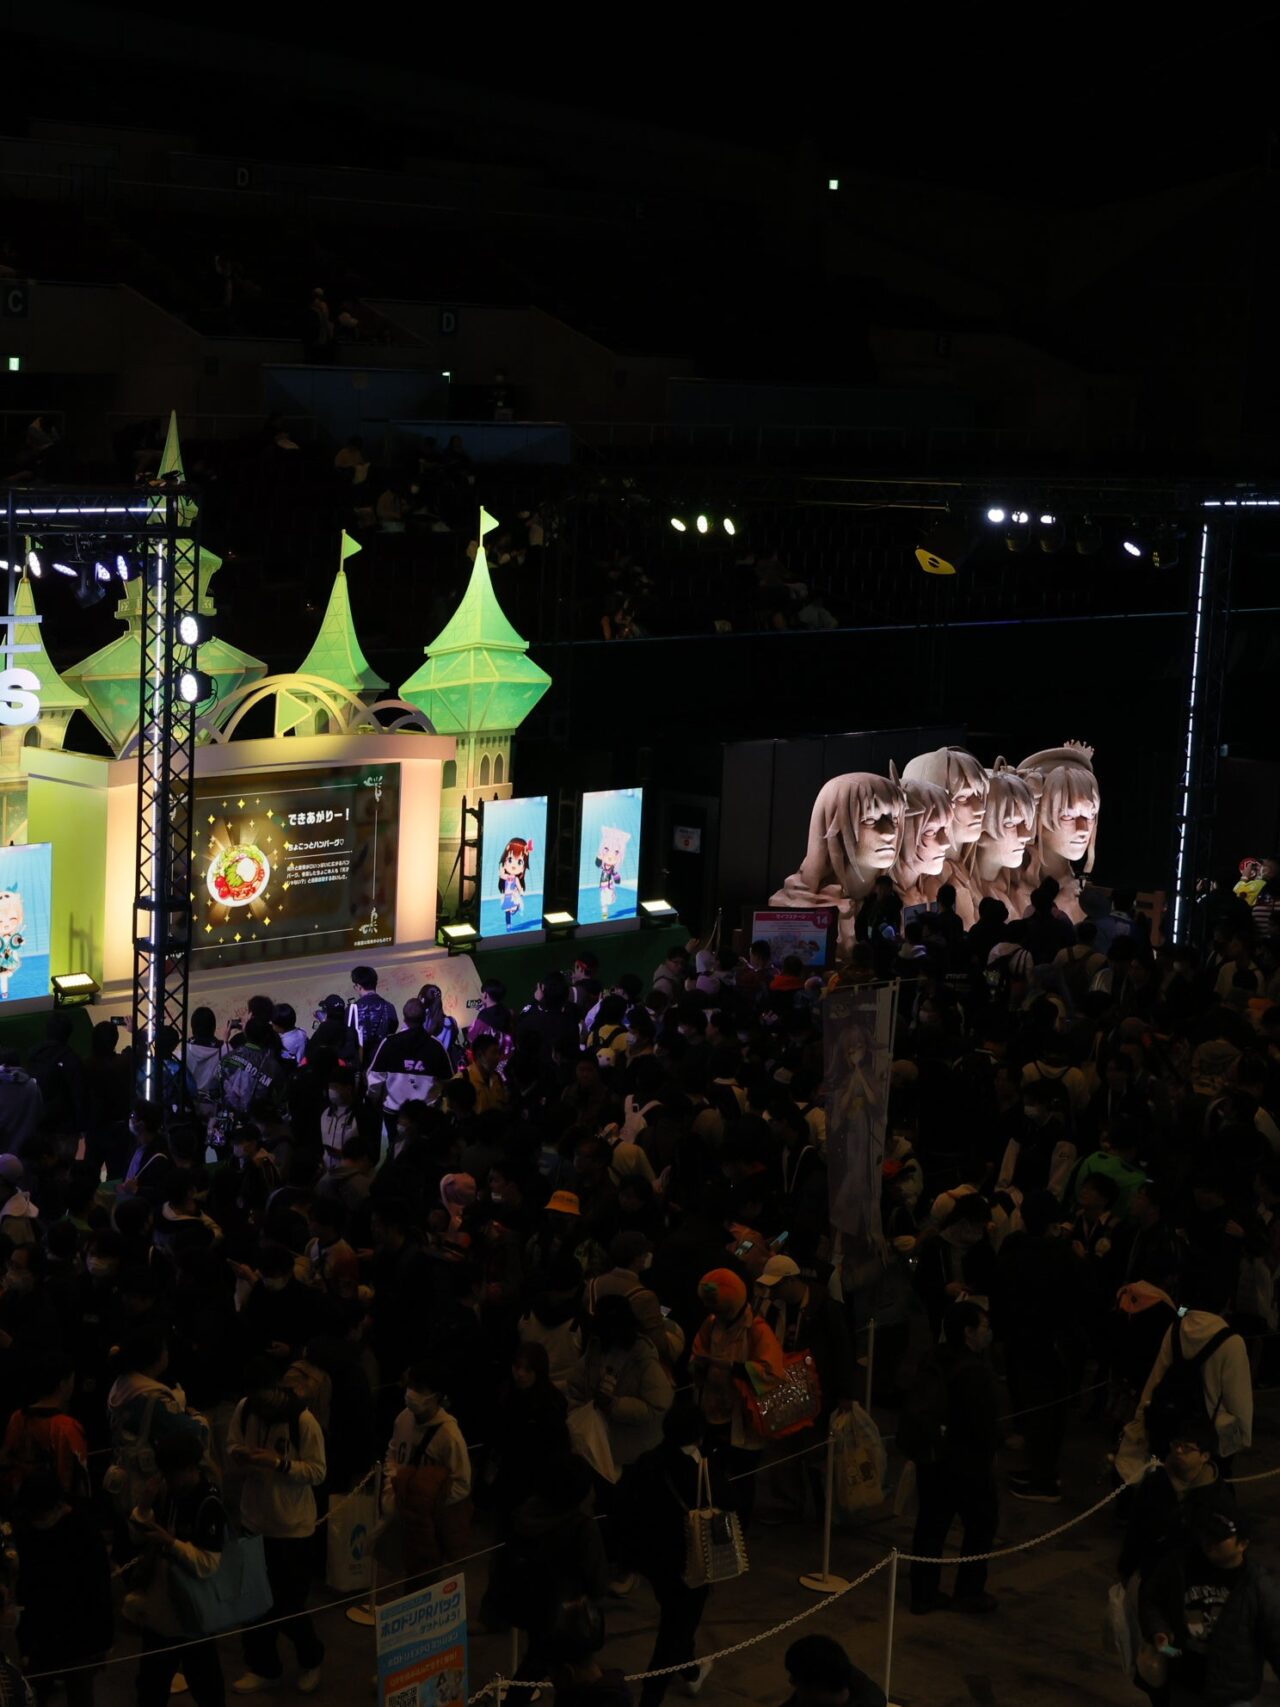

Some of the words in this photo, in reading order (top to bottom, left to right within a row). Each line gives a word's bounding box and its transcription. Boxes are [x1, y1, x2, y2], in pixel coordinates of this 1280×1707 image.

[7, 289, 23, 312] C
[442, 312, 455, 332] D
[288, 808, 350, 825] できあがりー！
[816, 915, 829, 925] 14
[403, 1059, 425, 1072] 54
